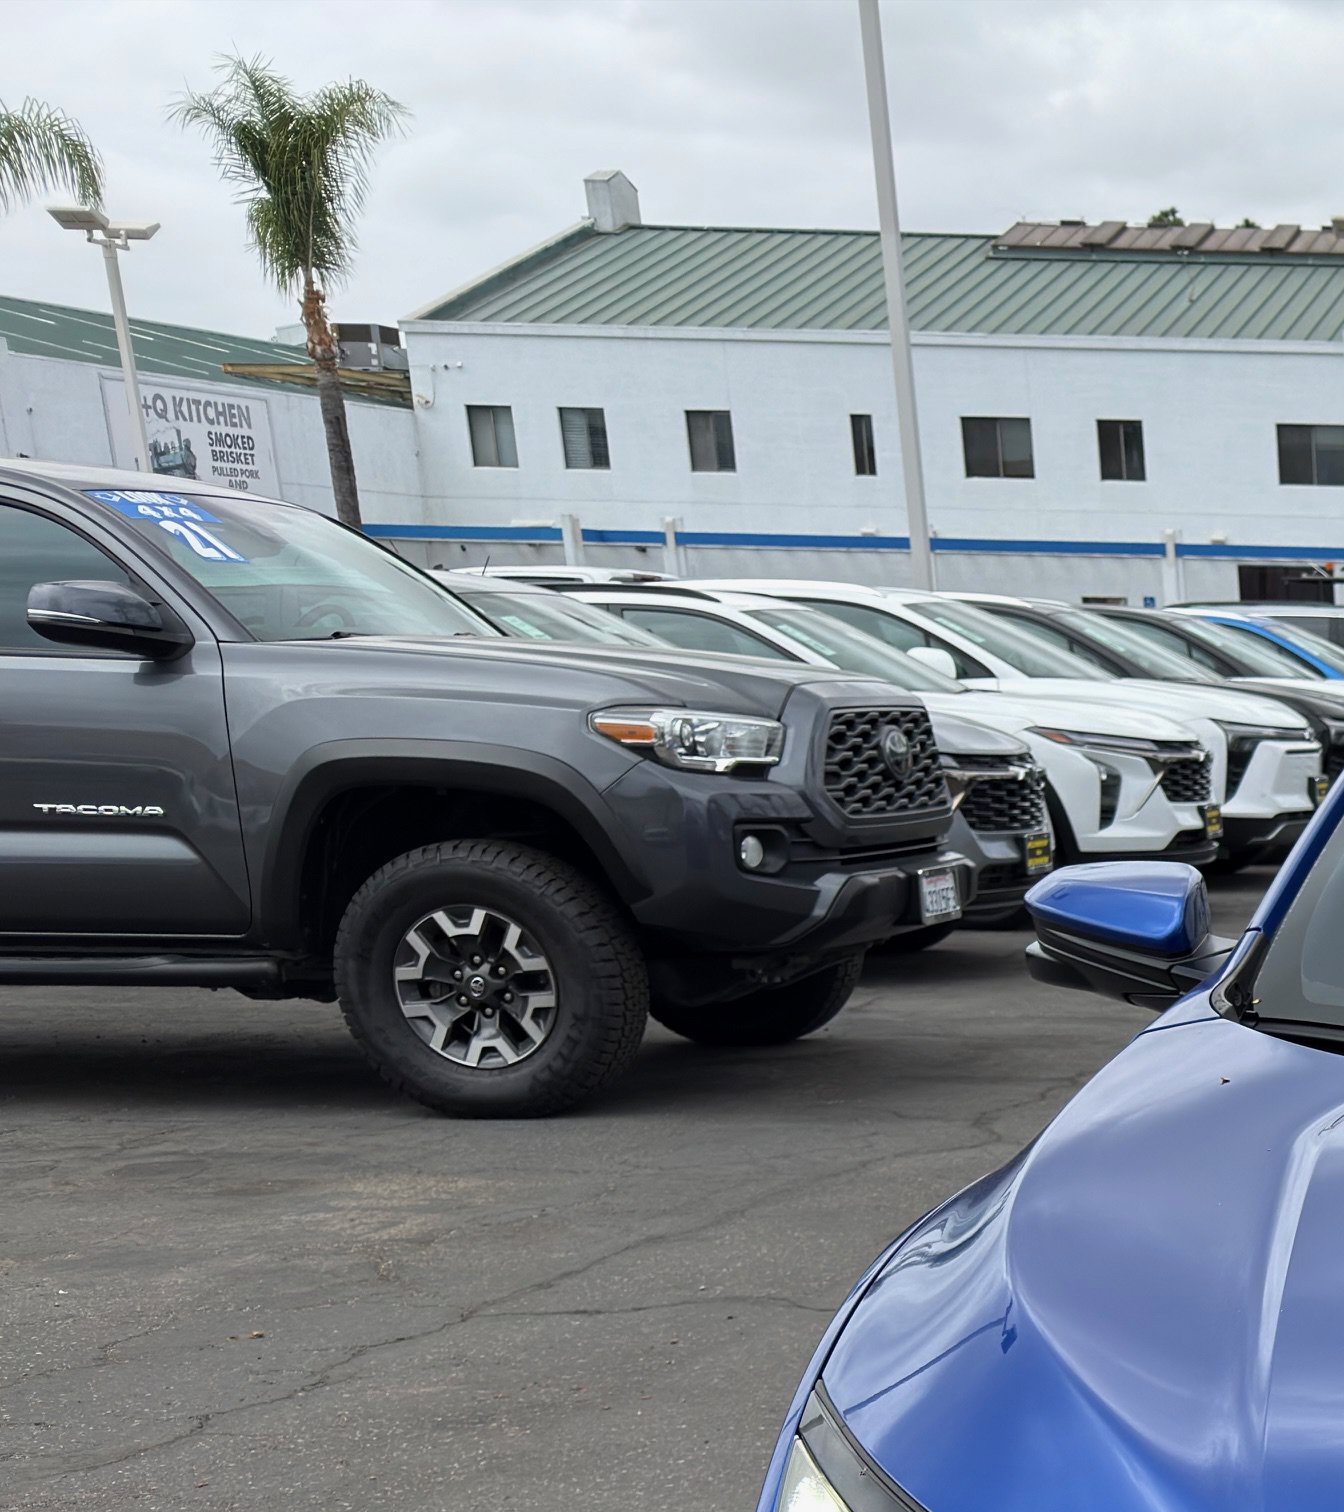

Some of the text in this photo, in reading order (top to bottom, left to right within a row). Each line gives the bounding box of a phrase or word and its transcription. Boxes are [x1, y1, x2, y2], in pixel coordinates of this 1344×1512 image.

[172, 396, 252, 429] KITCHEN
[207, 430, 255, 451] SMOKED
[211, 449, 255, 466] BRISKET
[212, 466, 260, 480] PULLED PORK
[228, 479, 249, 490] AND
[158, 520, 245, 561] 21
[33, 803, 165, 818] TACOMA
